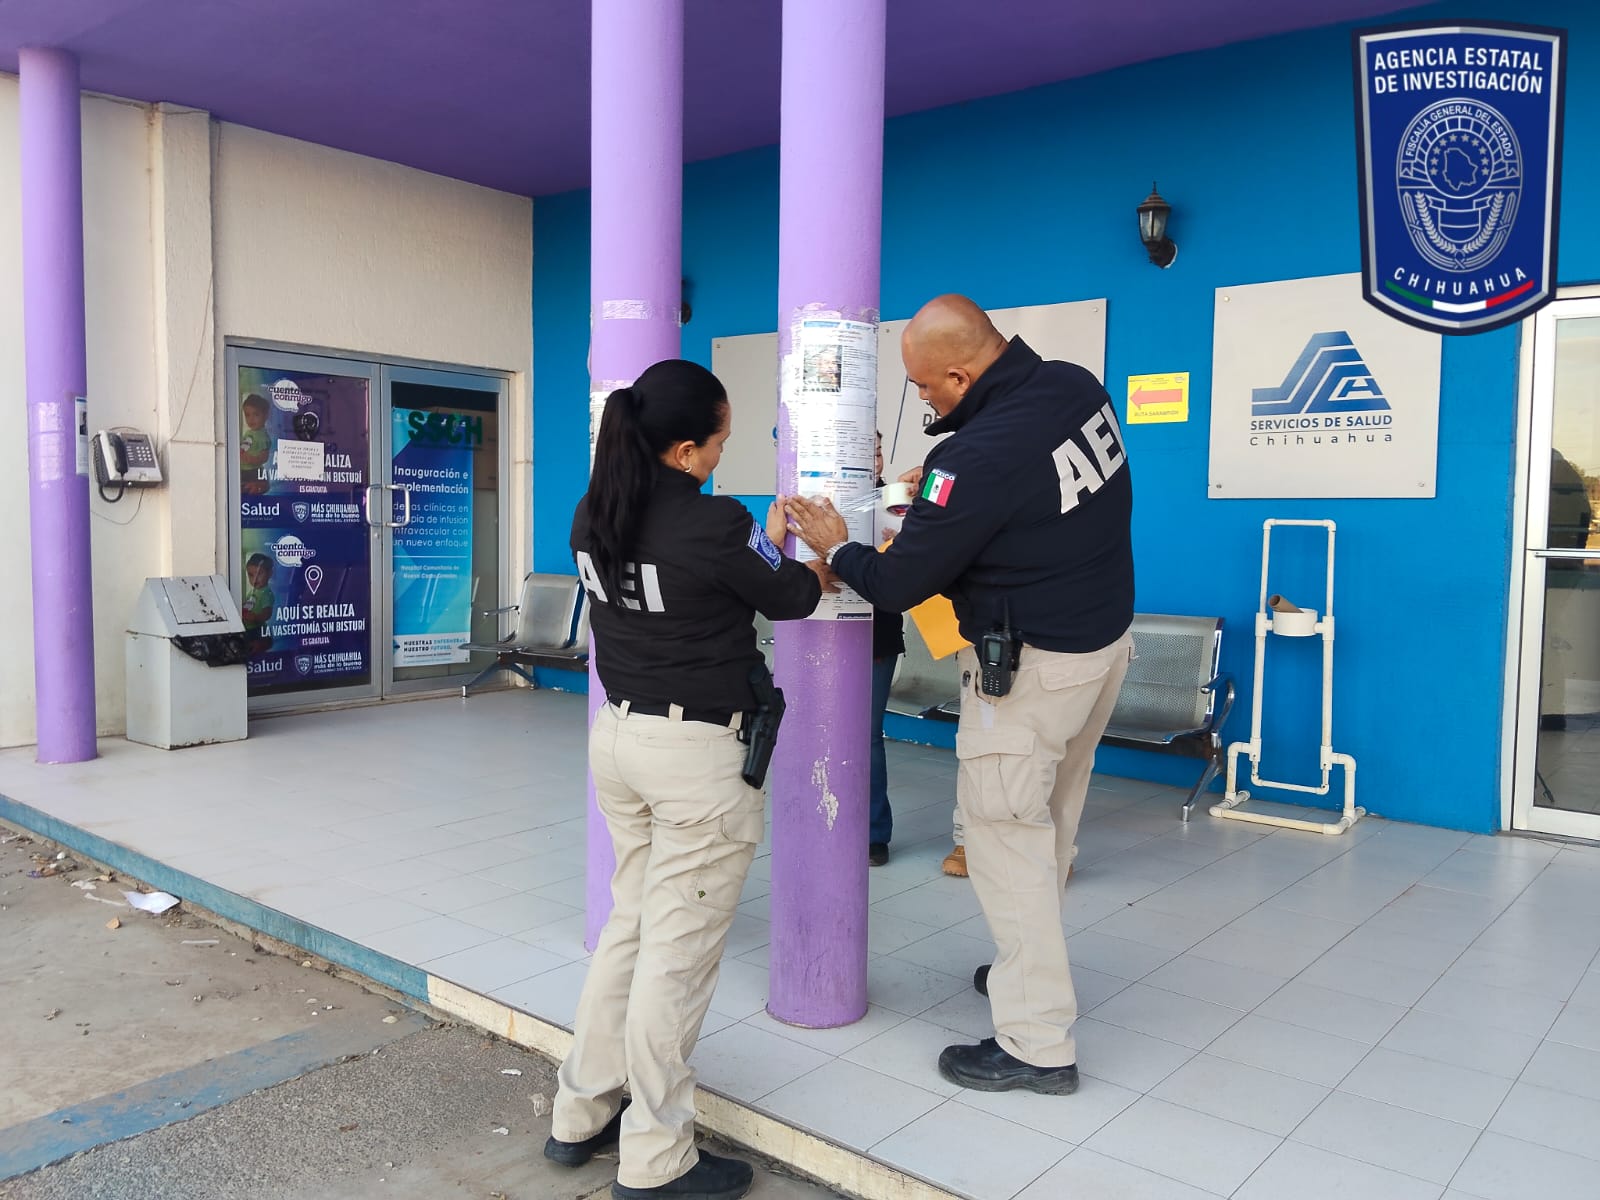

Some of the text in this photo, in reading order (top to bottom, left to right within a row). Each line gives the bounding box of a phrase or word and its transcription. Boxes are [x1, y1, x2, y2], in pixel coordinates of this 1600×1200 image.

[268, 386, 300, 395] cuenta
[274, 394, 312, 405] conmigo
[1250, 415, 1392, 430] SERVICIOS DE SALUD
[1250, 433, 1392, 446] Chihuahua
[1051, 402, 1127, 514] AEI
[257, 469, 267, 480] LA
[333, 470, 362, 483] BISTURÍ
[394, 465, 460, 479] Inauguración
[241, 502, 280, 516] Salud
[325, 503, 359, 513] CHIHUAHUA
[426, 515, 437, 523] de
[394, 527, 450, 535] ntravascular
[271, 542, 304, 550] cuenta
[277, 550, 315, 559] conmigo
[276, 603, 355, 622] AQUÍ SE REALIZA
[261, 618, 366, 637] LA VASECTOMÍA SIN BISTURÍ
[328, 651, 362, 663] CHIHUAHUA
[247, 657, 283, 673] Salud
